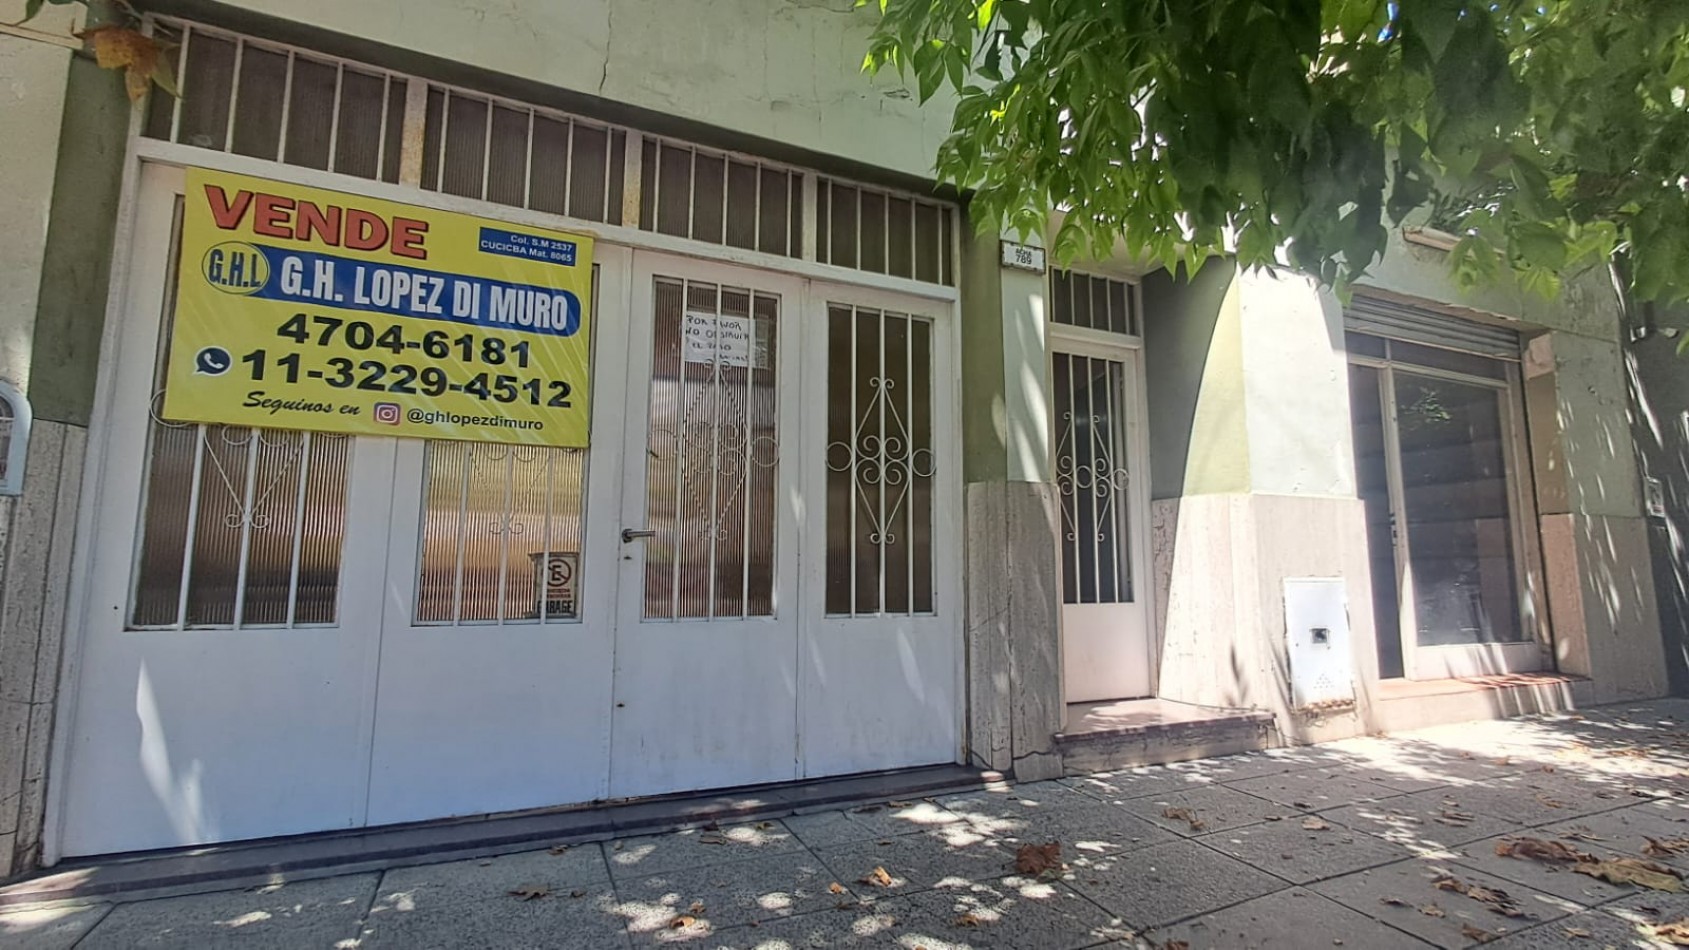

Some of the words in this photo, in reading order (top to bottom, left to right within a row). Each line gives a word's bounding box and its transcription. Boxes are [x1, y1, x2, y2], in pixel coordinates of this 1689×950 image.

[204, 184, 429, 261] VENDE
[480, 240, 527, 254] CUCICBA
[528, 247, 549, 259] Mat.
[550, 251, 572, 262] 8065
[510, 234, 530, 245] Col.
[531, 238, 549, 249] S.M
[550, 241, 573, 252] 2537
[1015, 254, 1032, 264] 789
[280, 255, 343, 302] G.H.
[354, 266, 445, 314] LOPEZ
[452, 280, 481, 320] DI
[489, 285, 568, 331] MURO
[712, 318, 742, 331] FVOR
[277, 313, 529, 368] 4704-6181
[242, 349, 572, 408] 11-3229-4512
[243, 391, 334, 415] Seguinos
[339, 404, 361, 416] en
[407, 408, 544, 431] @ghlopezdimuro
[537, 600, 573, 614] GRAGE
